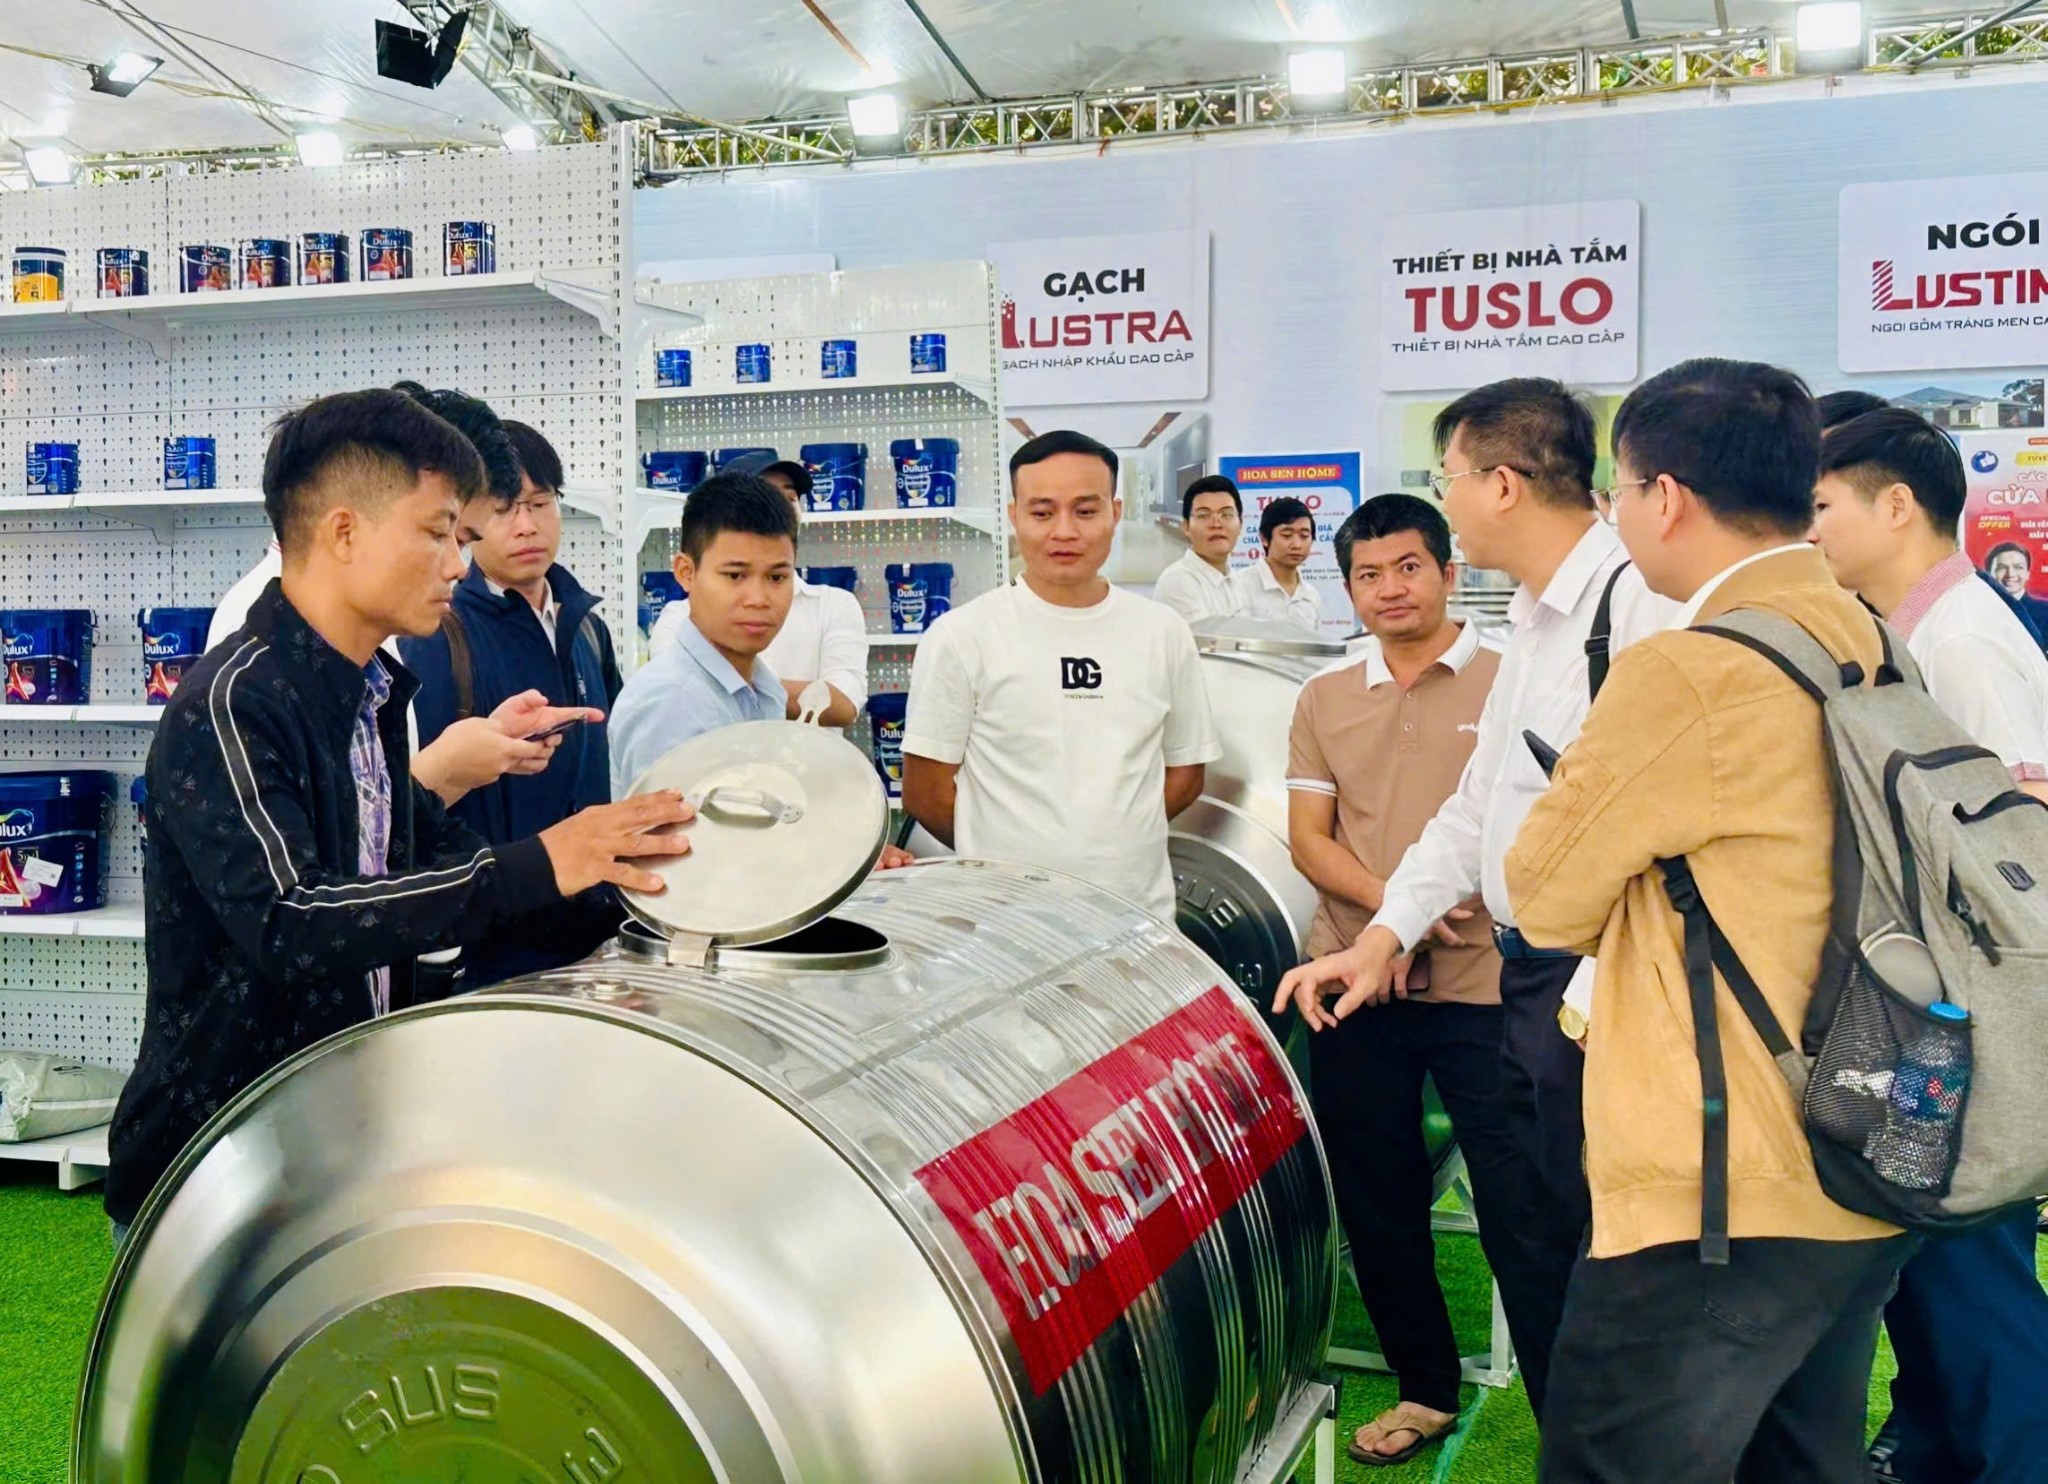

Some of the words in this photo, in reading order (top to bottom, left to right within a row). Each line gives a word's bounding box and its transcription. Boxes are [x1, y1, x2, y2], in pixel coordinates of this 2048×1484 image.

[1928, 212, 2040, 250] NGÓI
[1393, 248, 1464, 275] THIẾT
[1473, 253, 1497, 274] BỊ
[1507, 244, 1562, 268] NHÀ
[1570, 238, 1627, 264] TẮM
[1044, 268, 1145, 302] GẠCH
[1405, 277, 1613, 333] TUSLO
[1001, 294, 1192, 349] LUSTRA
[1997, 317, 2029, 327] MEN
[1464, 335, 1502, 349] NHÀ
[1546, 335, 1583, 346] CAO
[1129, 354, 1160, 364] CAO
[902, 464, 930, 473] Dulux
[1987, 484, 2040, 506] CỬA
[897, 589, 924, 598] Dulux
[144, 642, 175, 655] Dulux
[1060, 656, 1102, 690] DG
[340, 1363, 501, 1455] SUS
